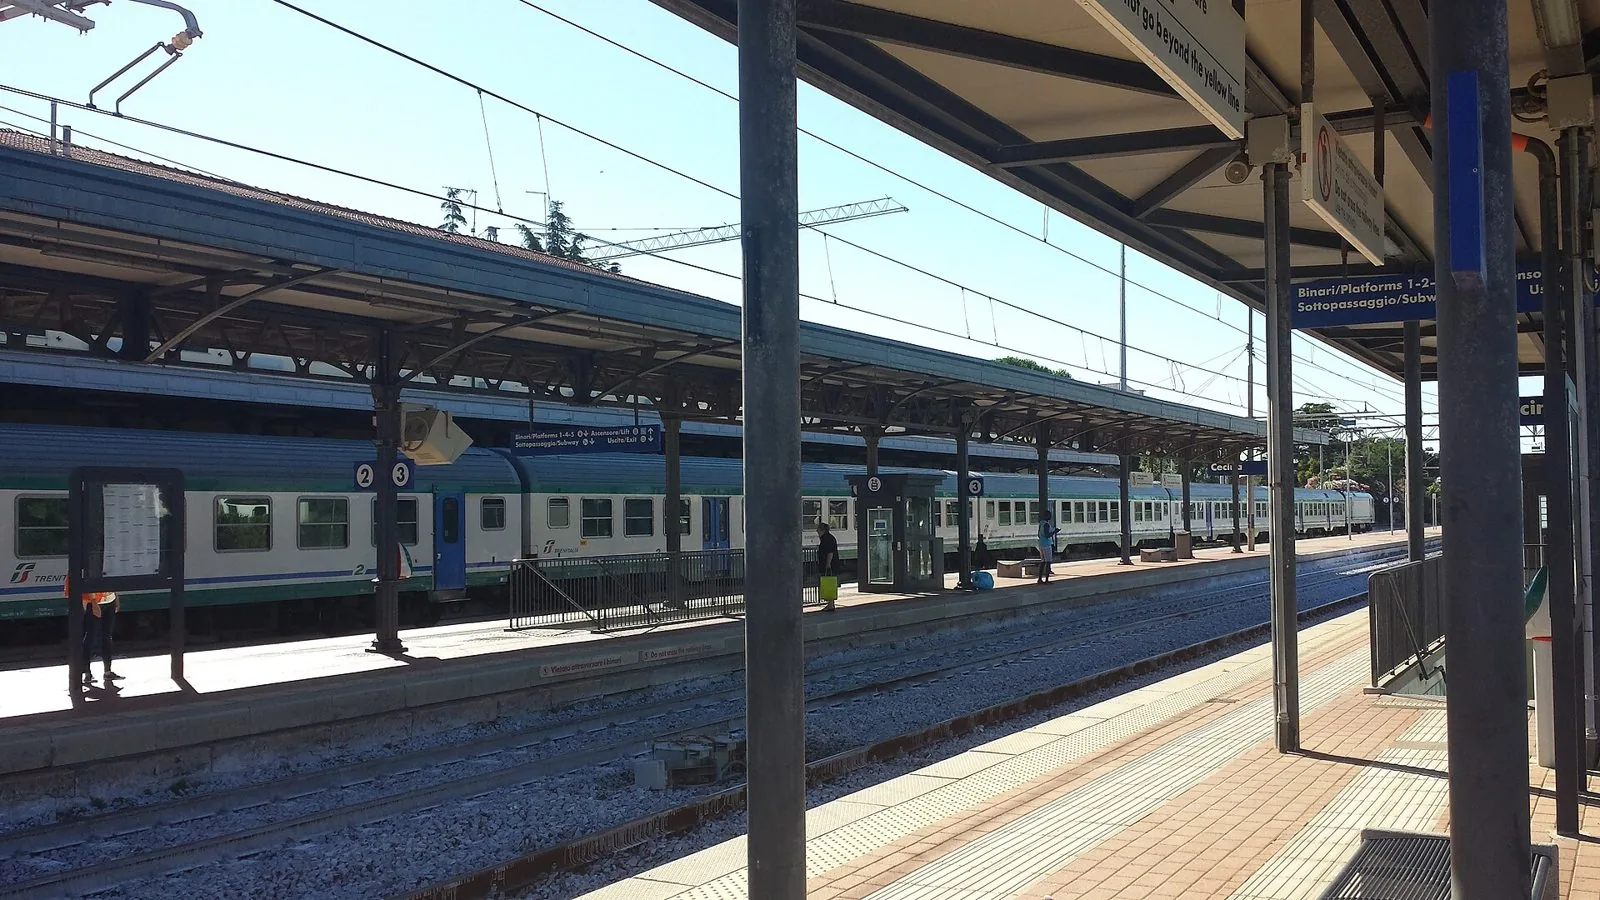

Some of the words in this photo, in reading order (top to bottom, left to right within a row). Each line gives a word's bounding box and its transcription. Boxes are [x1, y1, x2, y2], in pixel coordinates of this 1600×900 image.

[1142, 7, 1154, 30] go
[1156, 12, 1190, 64] beyond
[1190, 49, 1203, 77] the
[1204, 66, 1227, 100] yellow
[1227, 83, 1240, 112] line
[1298, 281, 1402, 298] Binari/Platforms
[515, 432, 558, 440] Binari/Platforms
[515, 440, 580, 448] Sottopassaggio/Subway
[361, 469, 369, 483] 2
[397, 467, 405, 482] 3
[972, 482, 979, 491] 3
[354, 564, 365, 576] 2
[550, 664, 571, 673] Vietato
